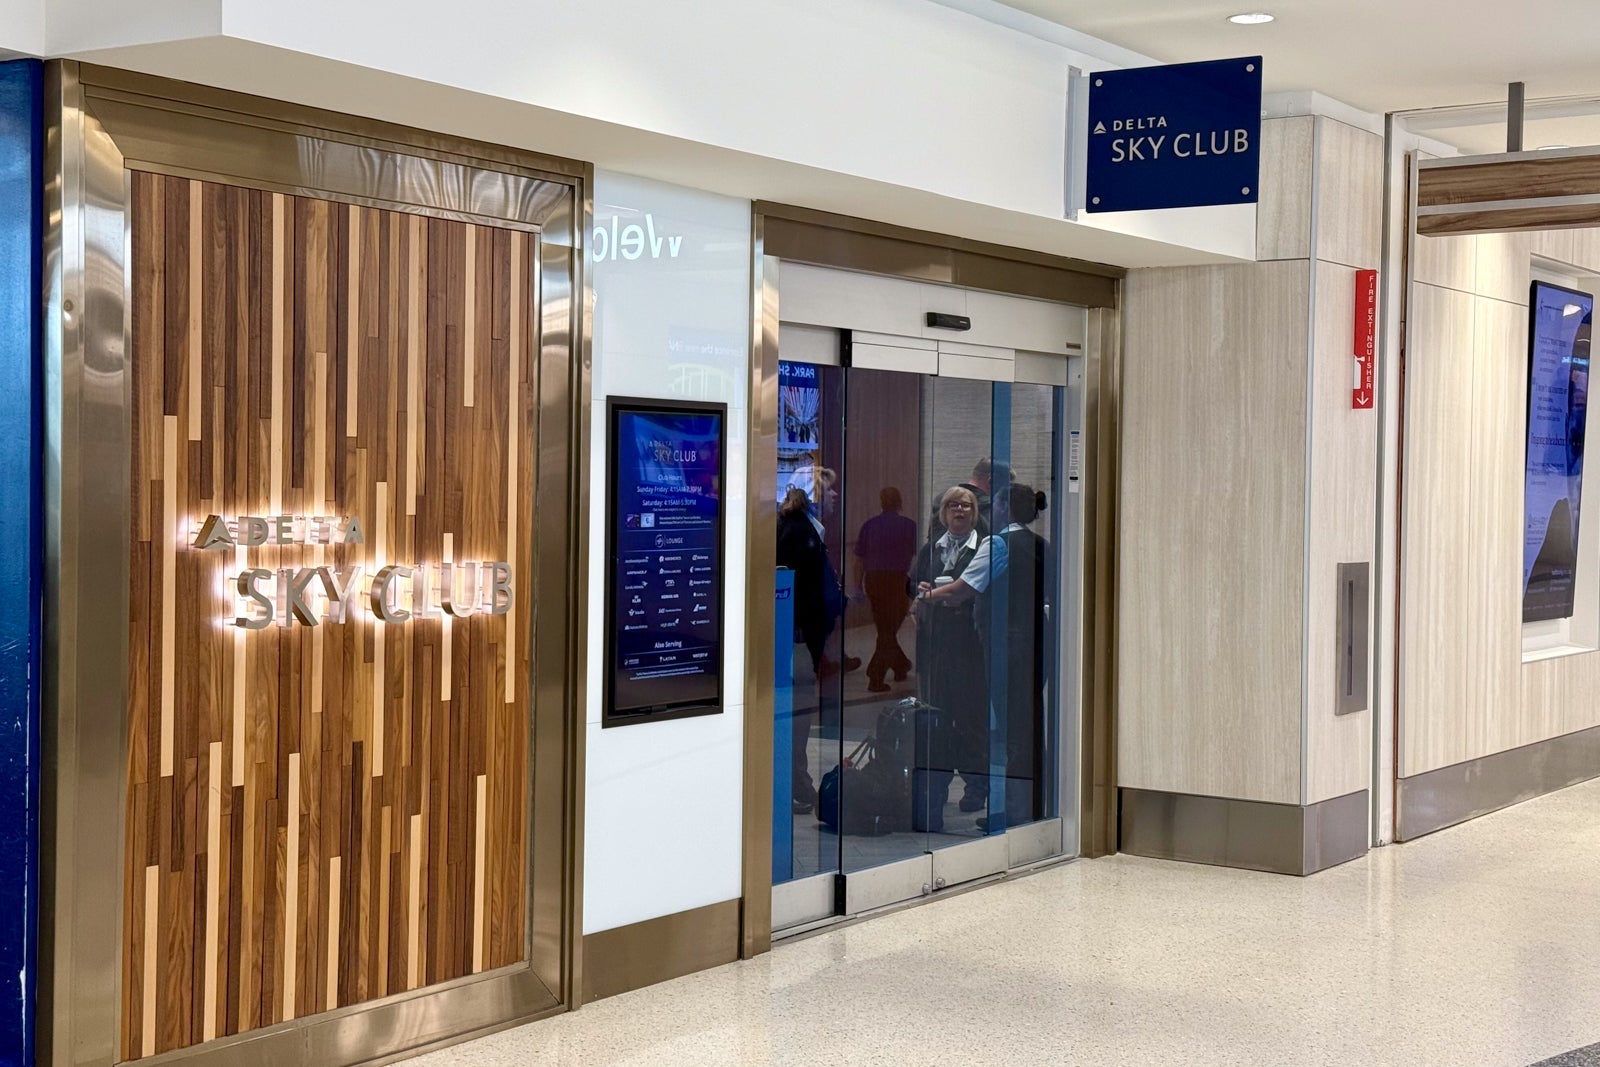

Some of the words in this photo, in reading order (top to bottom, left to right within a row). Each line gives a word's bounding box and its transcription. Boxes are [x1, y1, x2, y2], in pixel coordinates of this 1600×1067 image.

[1113, 116, 1168, 131] DELTA
[1111, 135, 1166, 163] SKY
[1173, 129, 1249, 157] CLUB
[654, 450, 671, 462] SKY
[673, 450, 697, 462] CLUB
[237, 515, 365, 546] DELTA
[236, 566, 361, 630] SKY
[371, 561, 514, 625] CLUB
[665, 640, 682, 648] Serving
